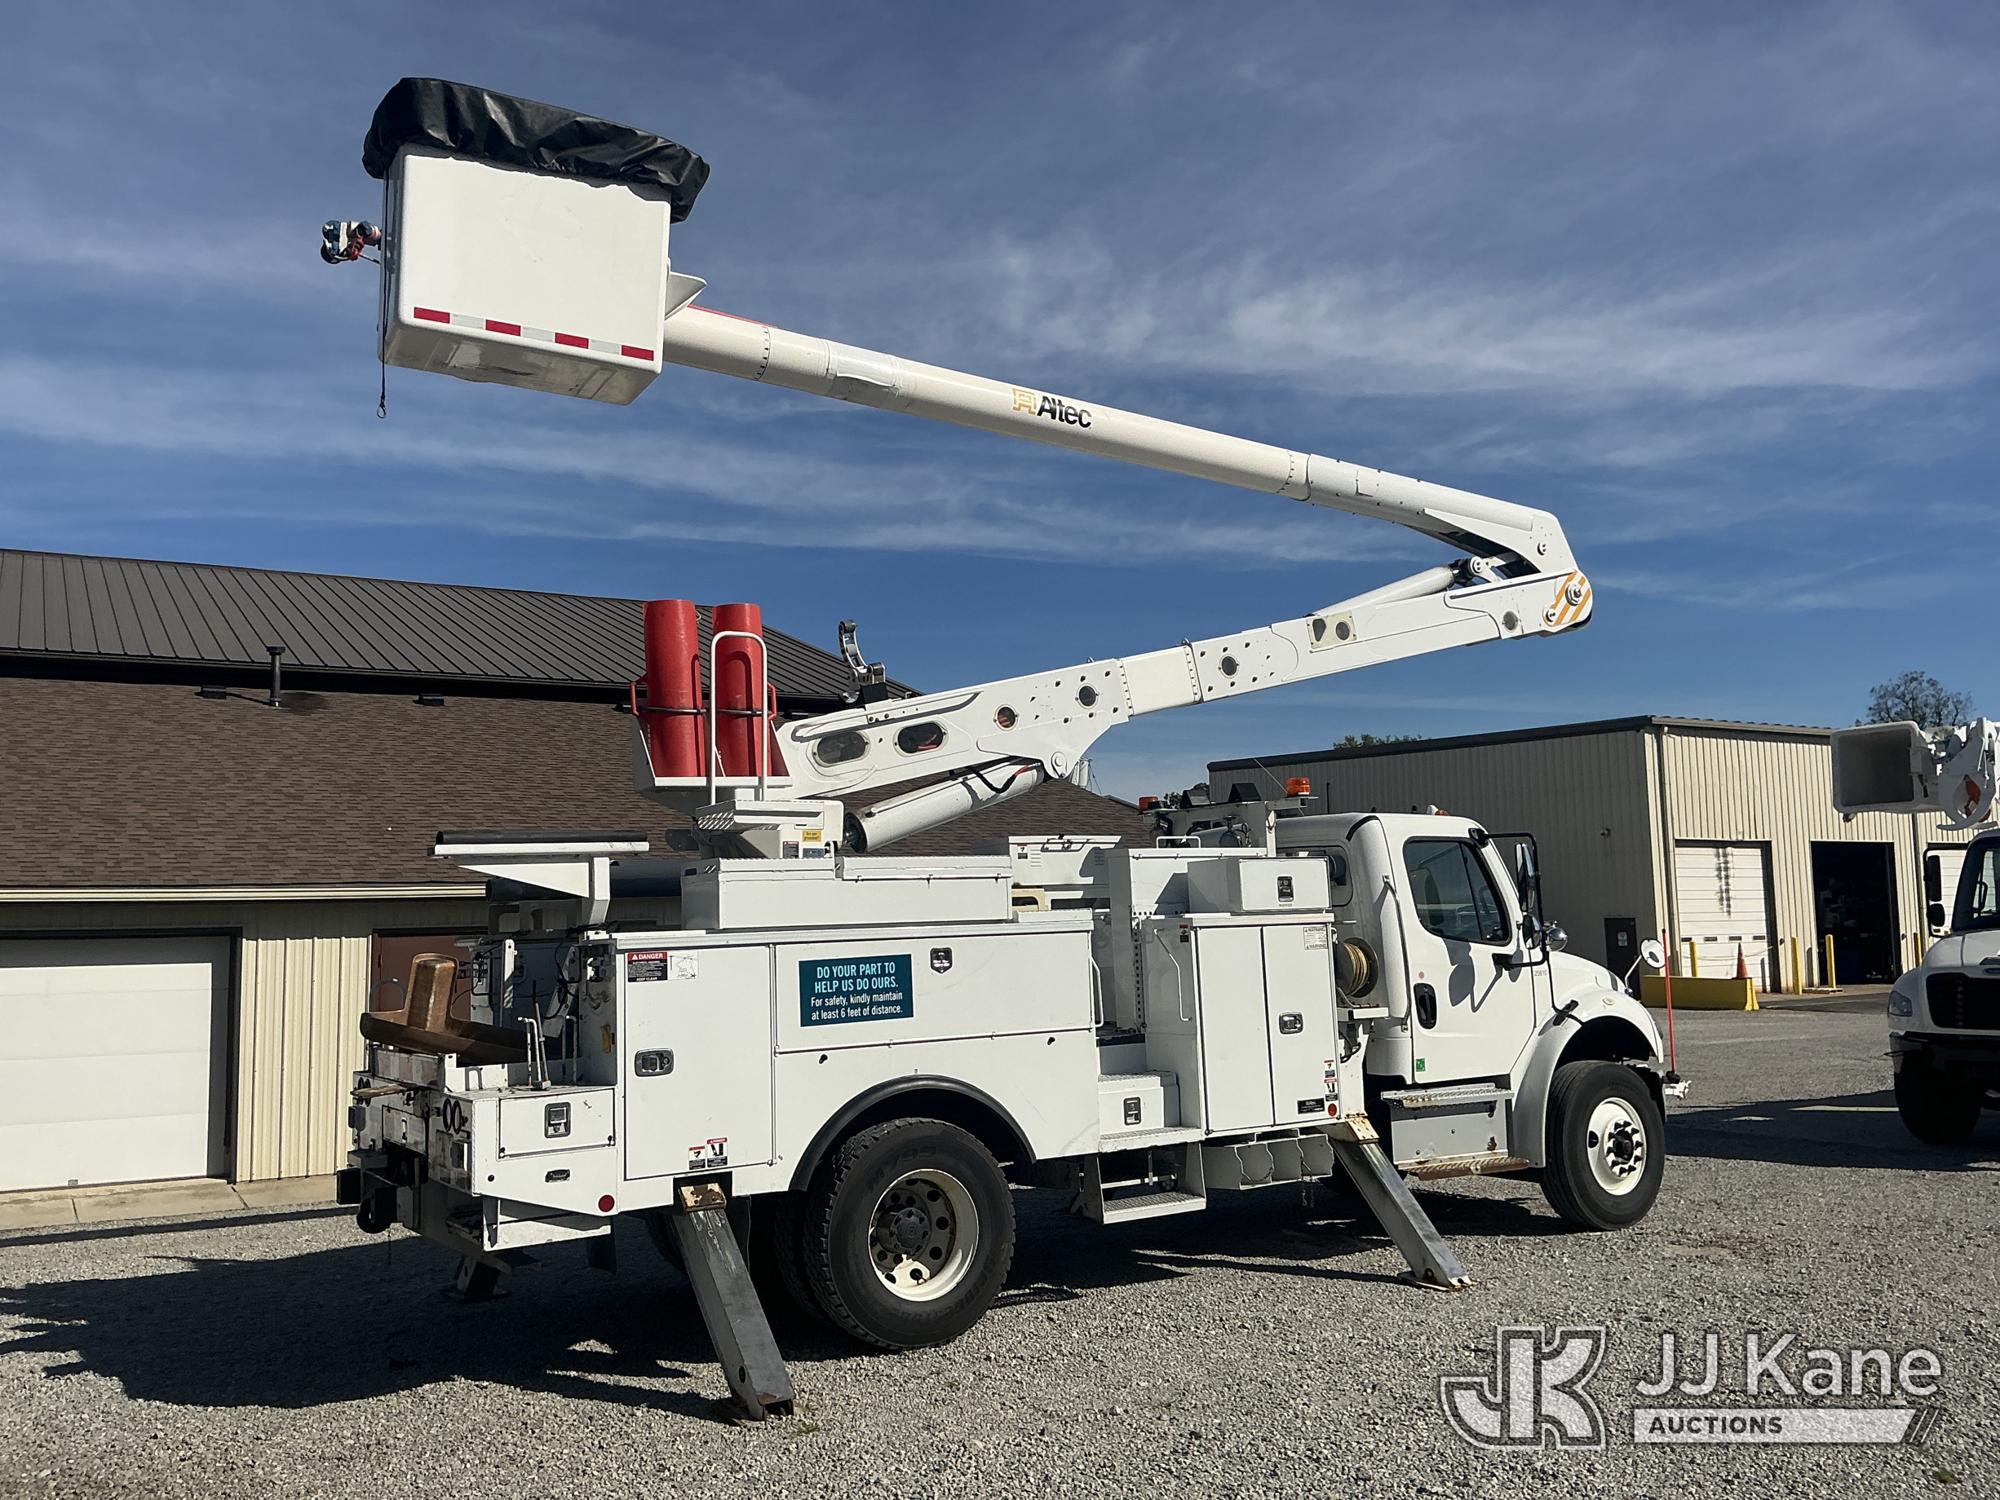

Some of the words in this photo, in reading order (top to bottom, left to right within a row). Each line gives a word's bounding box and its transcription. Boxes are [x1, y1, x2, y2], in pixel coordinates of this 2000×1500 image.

[1037, 396, 1092, 428] Altec
[816, 966, 830, 978] DO
[832, 964, 857, 978] YOUR
[860, 962, 882, 976] PART
[884, 962, 896, 974] TO
[814, 980, 838, 994] HELP
[842, 979, 854, 992] US
[856, 978, 869, 990] DO
[872, 976, 898, 988] OURS.
[811, 996, 822, 1007] For
[824, 995, 848, 1006] safety,
[850, 993, 871, 1004] kindly
[872, 991, 902, 1002] maintain
[812, 1010, 820, 1020] at
[821, 1008, 838, 1020] least
[840, 1008, 846, 1018] 6
[847, 1007, 860, 1017] feet
[862, 1006, 870, 1016] of
[872, 1005, 903, 1015] distance.
